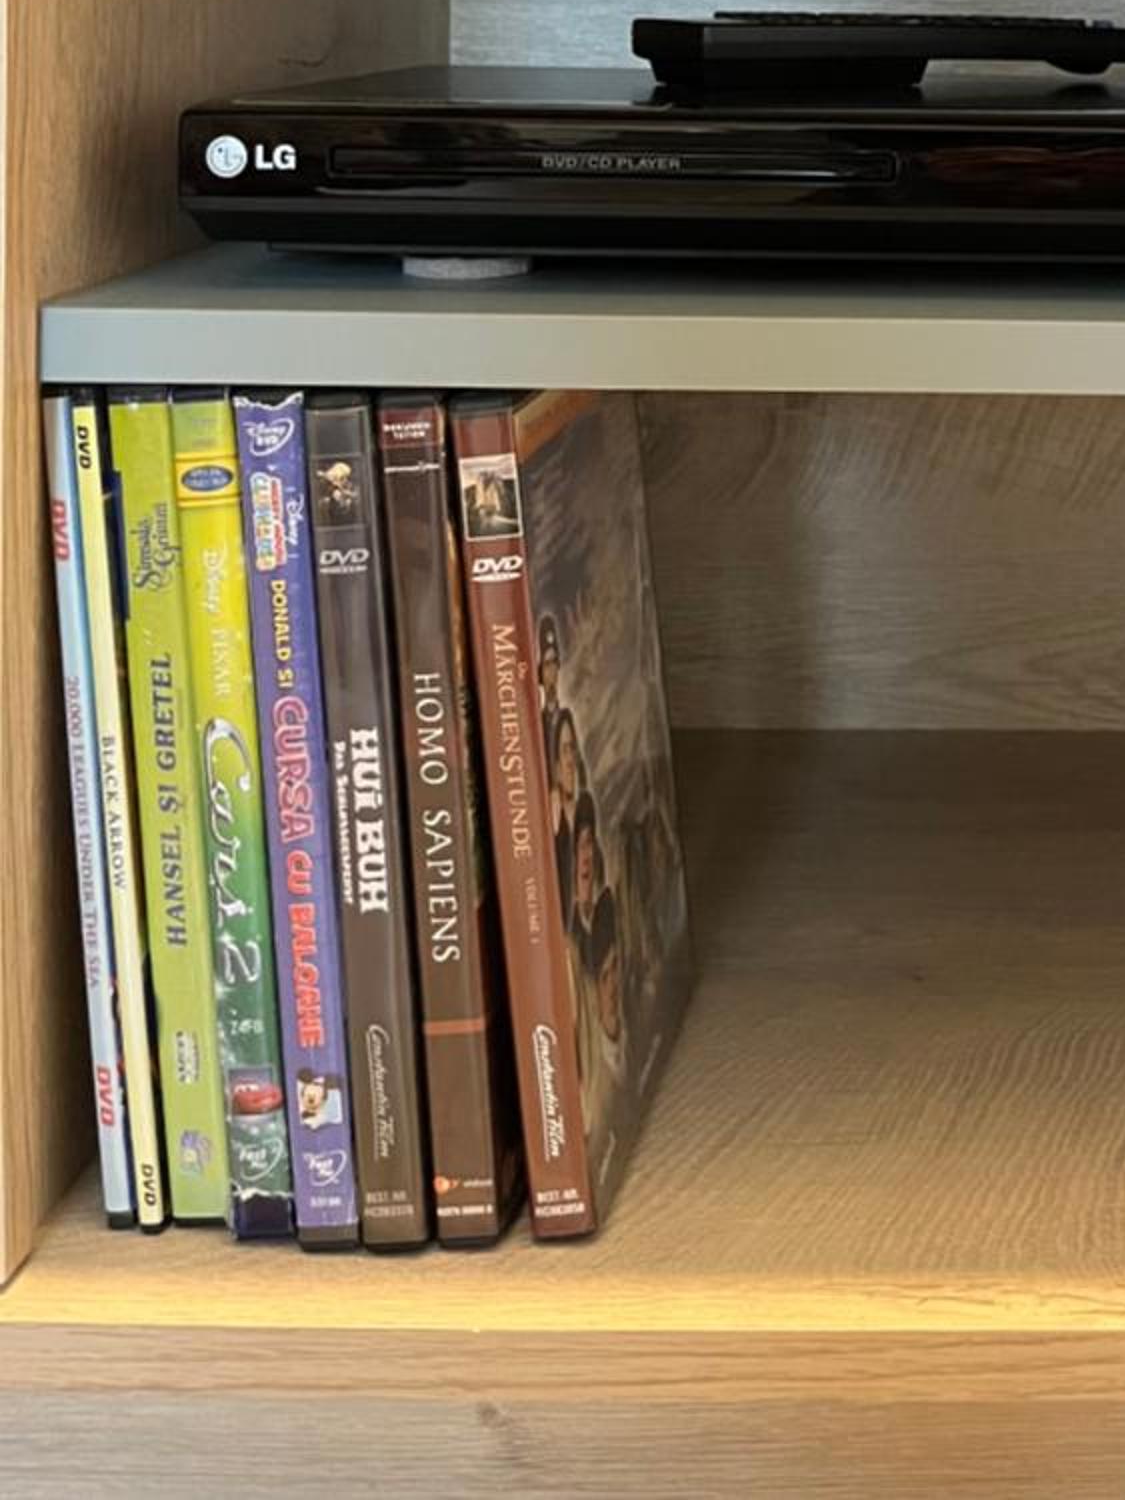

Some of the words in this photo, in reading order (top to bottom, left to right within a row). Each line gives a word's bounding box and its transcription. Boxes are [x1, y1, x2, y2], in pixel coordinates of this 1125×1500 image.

[255, 144, 297, 170] LG
[542, 156, 613, 170] DVD/CD
[617, 156, 682, 170] PLAYER
[76, 425, 92, 469] DVD
[51, 500, 70, 561] DVD
[319, 548, 369, 565] DVD
[472, 555, 524, 574] DVD
[270, 579, 293, 661] DONALD
[151, 652, 177, 771] GRETEL
[413, 672, 448, 785] HOMO
[273, 695, 315, 844] CURSA
[160, 824, 188, 946] HANSEL
[286, 849, 314, 896] CU
[354, 819, 389, 915] BUH
[423, 809, 460, 962] SAPIENS
[83, 906, 98, 952] THE
[96, 1065, 115, 1127] DVD
[141, 1163, 156, 1207] DVD
